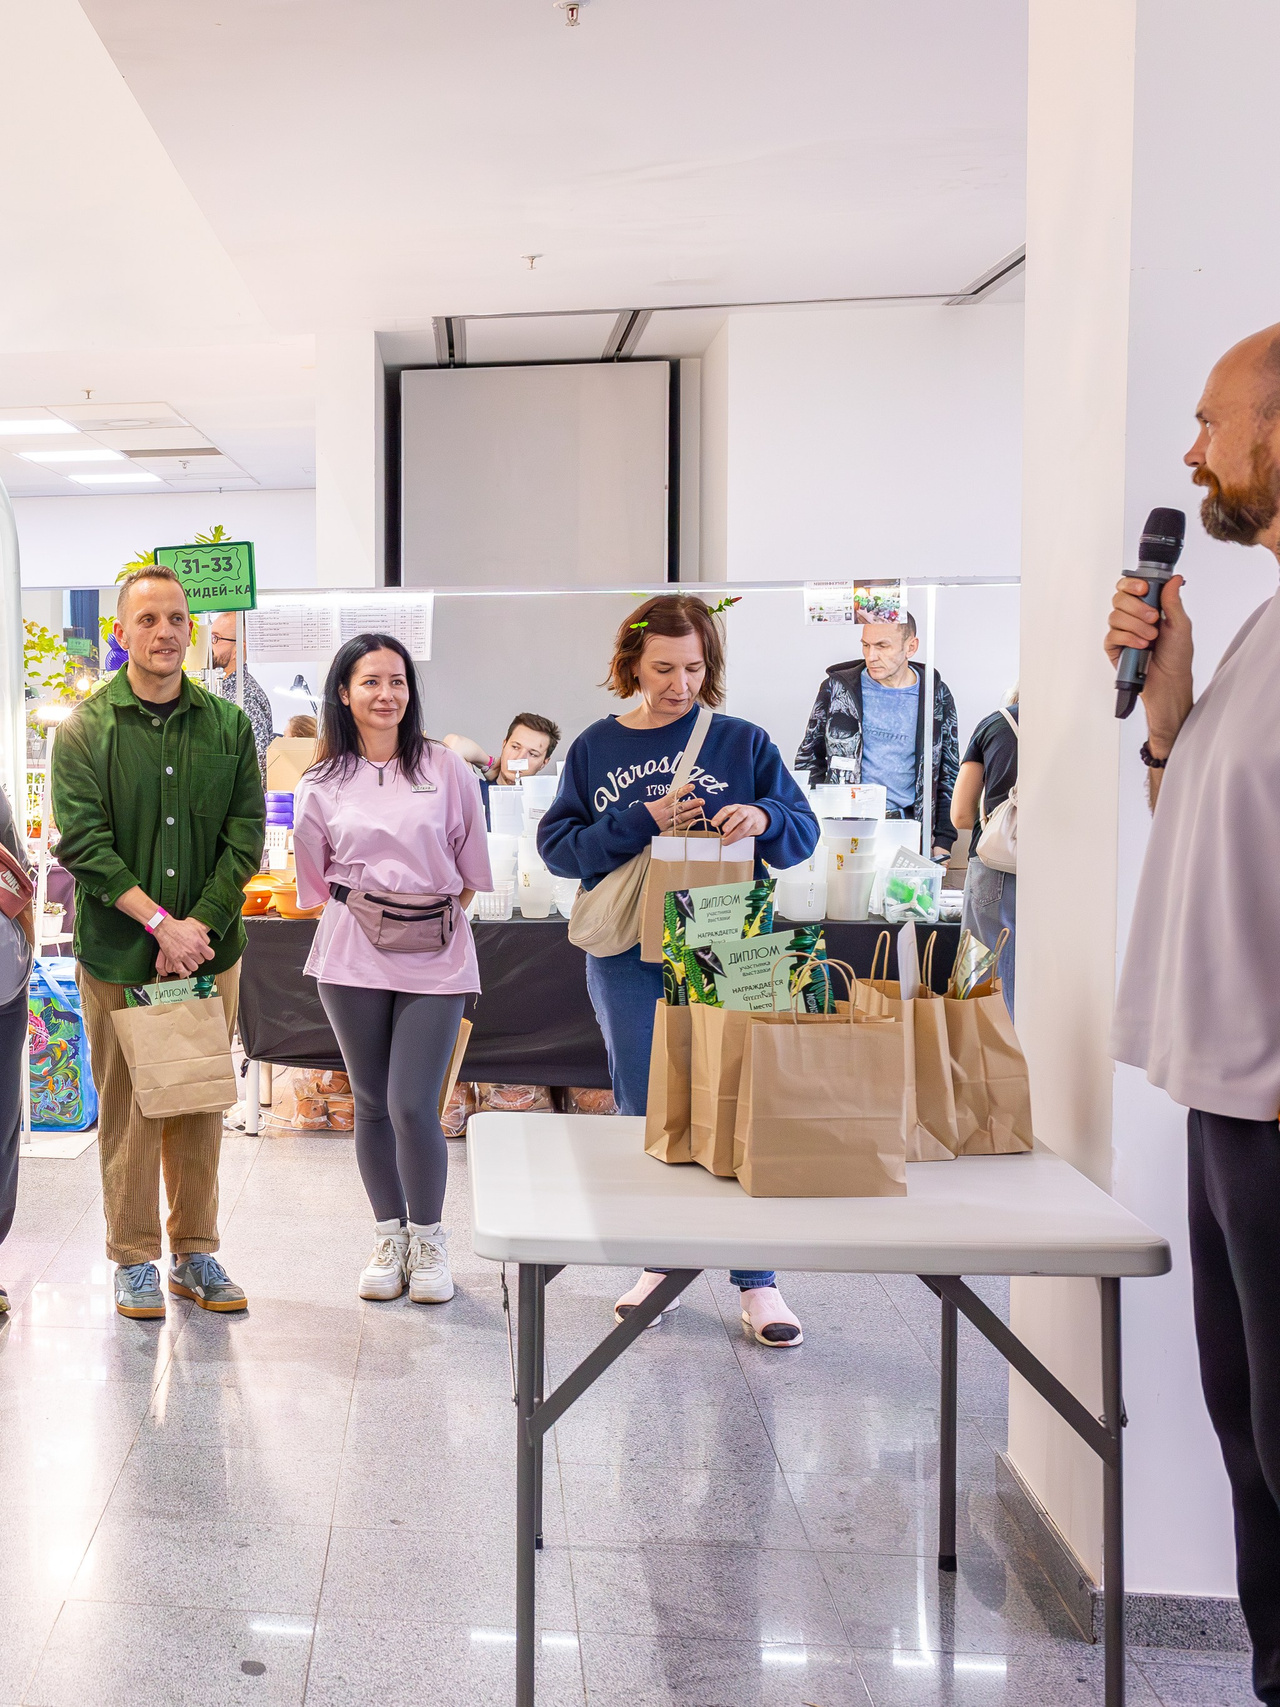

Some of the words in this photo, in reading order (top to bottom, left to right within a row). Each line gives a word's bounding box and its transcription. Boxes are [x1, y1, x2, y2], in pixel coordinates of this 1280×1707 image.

[181, 556, 233, 574] 31-33
[185, 584, 251, 598] ХИДЕЙ-КА
[2, 870, 20, 891] NIKE
[699, 894, 741, 910] ДИПЛОМ
[697, 928, 738, 938] НАГРАЖДАЕТСЯ
[728, 945, 780, 965] ДИПЛОМ
[732, 979, 784, 994] НАГРАЖДАЕТСЯ
[753, 1002, 773, 1011] место
